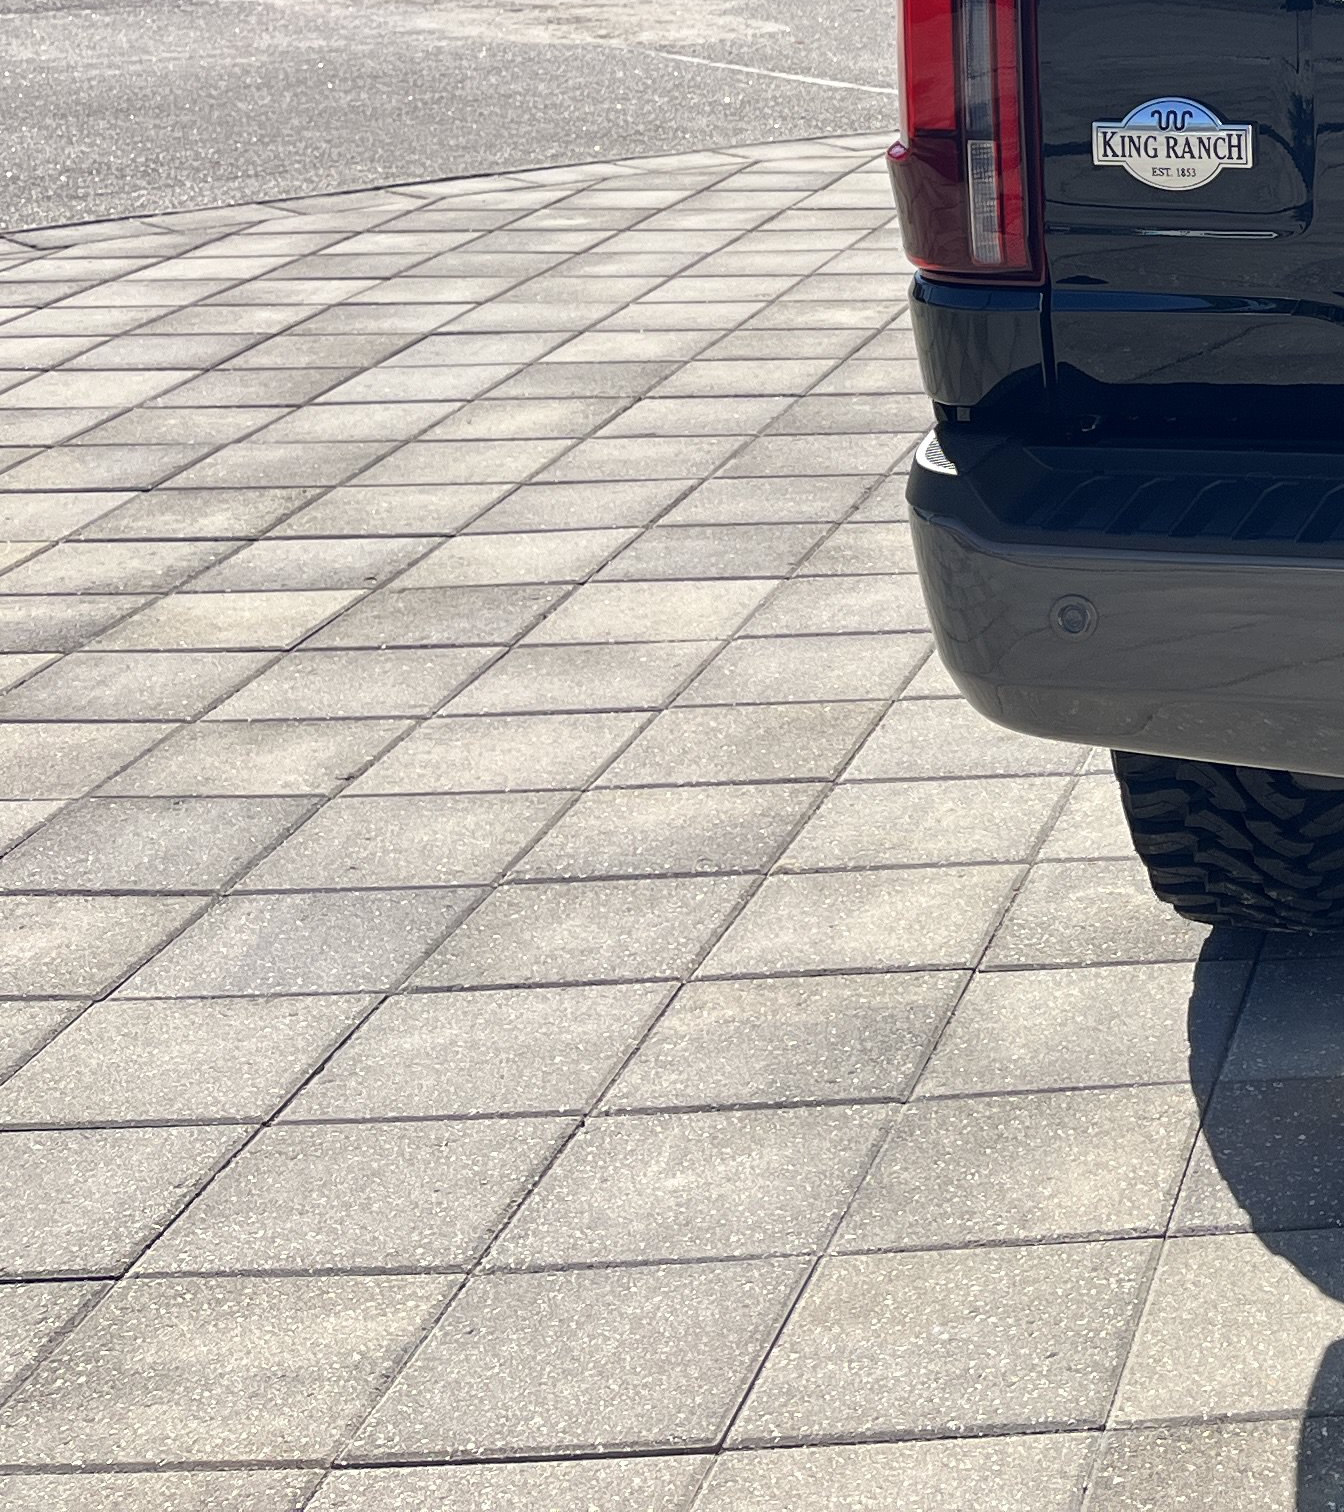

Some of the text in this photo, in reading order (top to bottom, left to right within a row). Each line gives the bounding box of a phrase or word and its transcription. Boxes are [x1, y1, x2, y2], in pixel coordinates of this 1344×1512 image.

[1101, 131, 1243, 160] KING RANCH
[1151, 167, 1197, 178] EST. 1853
